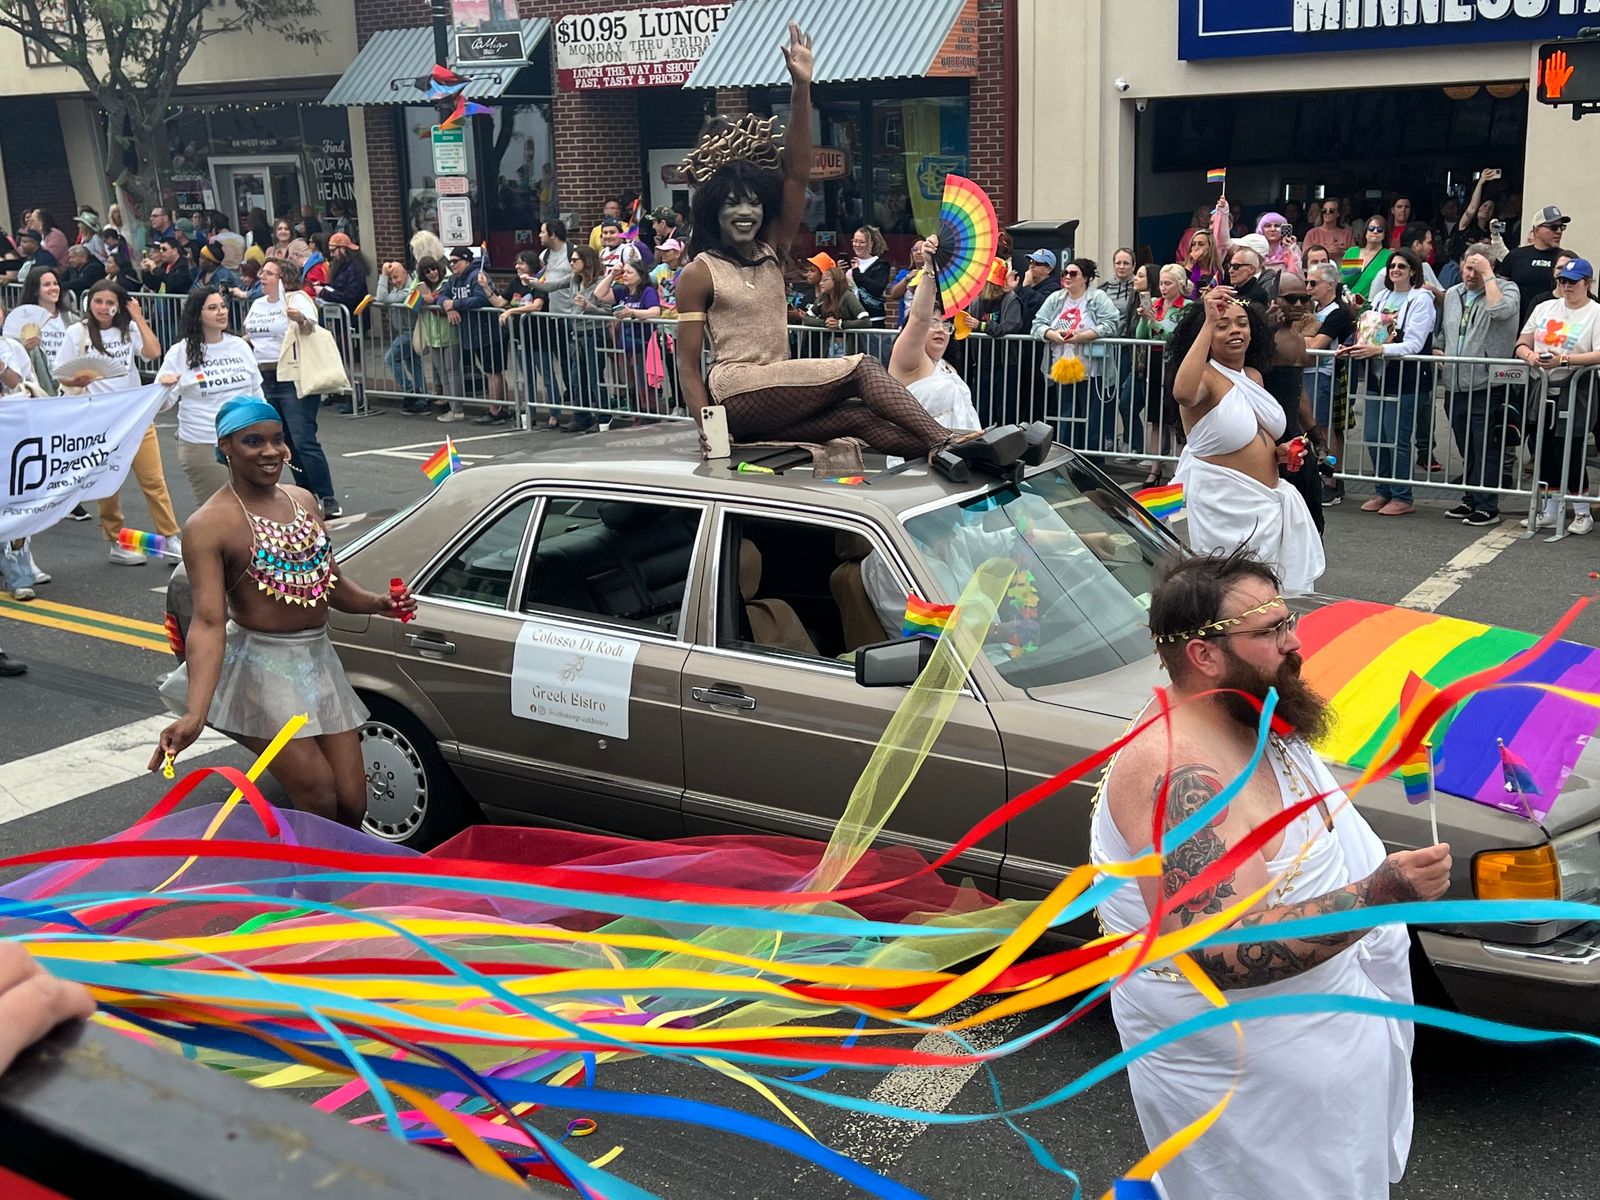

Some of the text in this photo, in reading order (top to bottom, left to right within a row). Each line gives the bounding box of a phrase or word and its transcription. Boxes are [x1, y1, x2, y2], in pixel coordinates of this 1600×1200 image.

[558, 7, 730, 46] $10.95 LUNCH
[569, 34, 714, 56] MONDAY THRU FRIDA
[587, 50, 623, 65] NOON
[636, 49, 657, 61] TIL
[573, 67, 603, 79] LUNCH
[605, 66, 625, 77] THE
[627, 64, 650, 76] WAY
[653, 63, 664, 75] IT
[575, 73, 685, 89] FAST, TASTY & PRICED
[322, 139, 345, 153] Find
[311, 157, 336, 179] YOUR
[333, 172, 343, 181] TO
[209, 375, 246, 387] FOR ALL
[1494, 371, 1521, 379] SONCO
[532, 629, 576, 648] Colosso
[579, 637, 592, 652] Di
[532, 685, 606, 712] Greek Bistro
